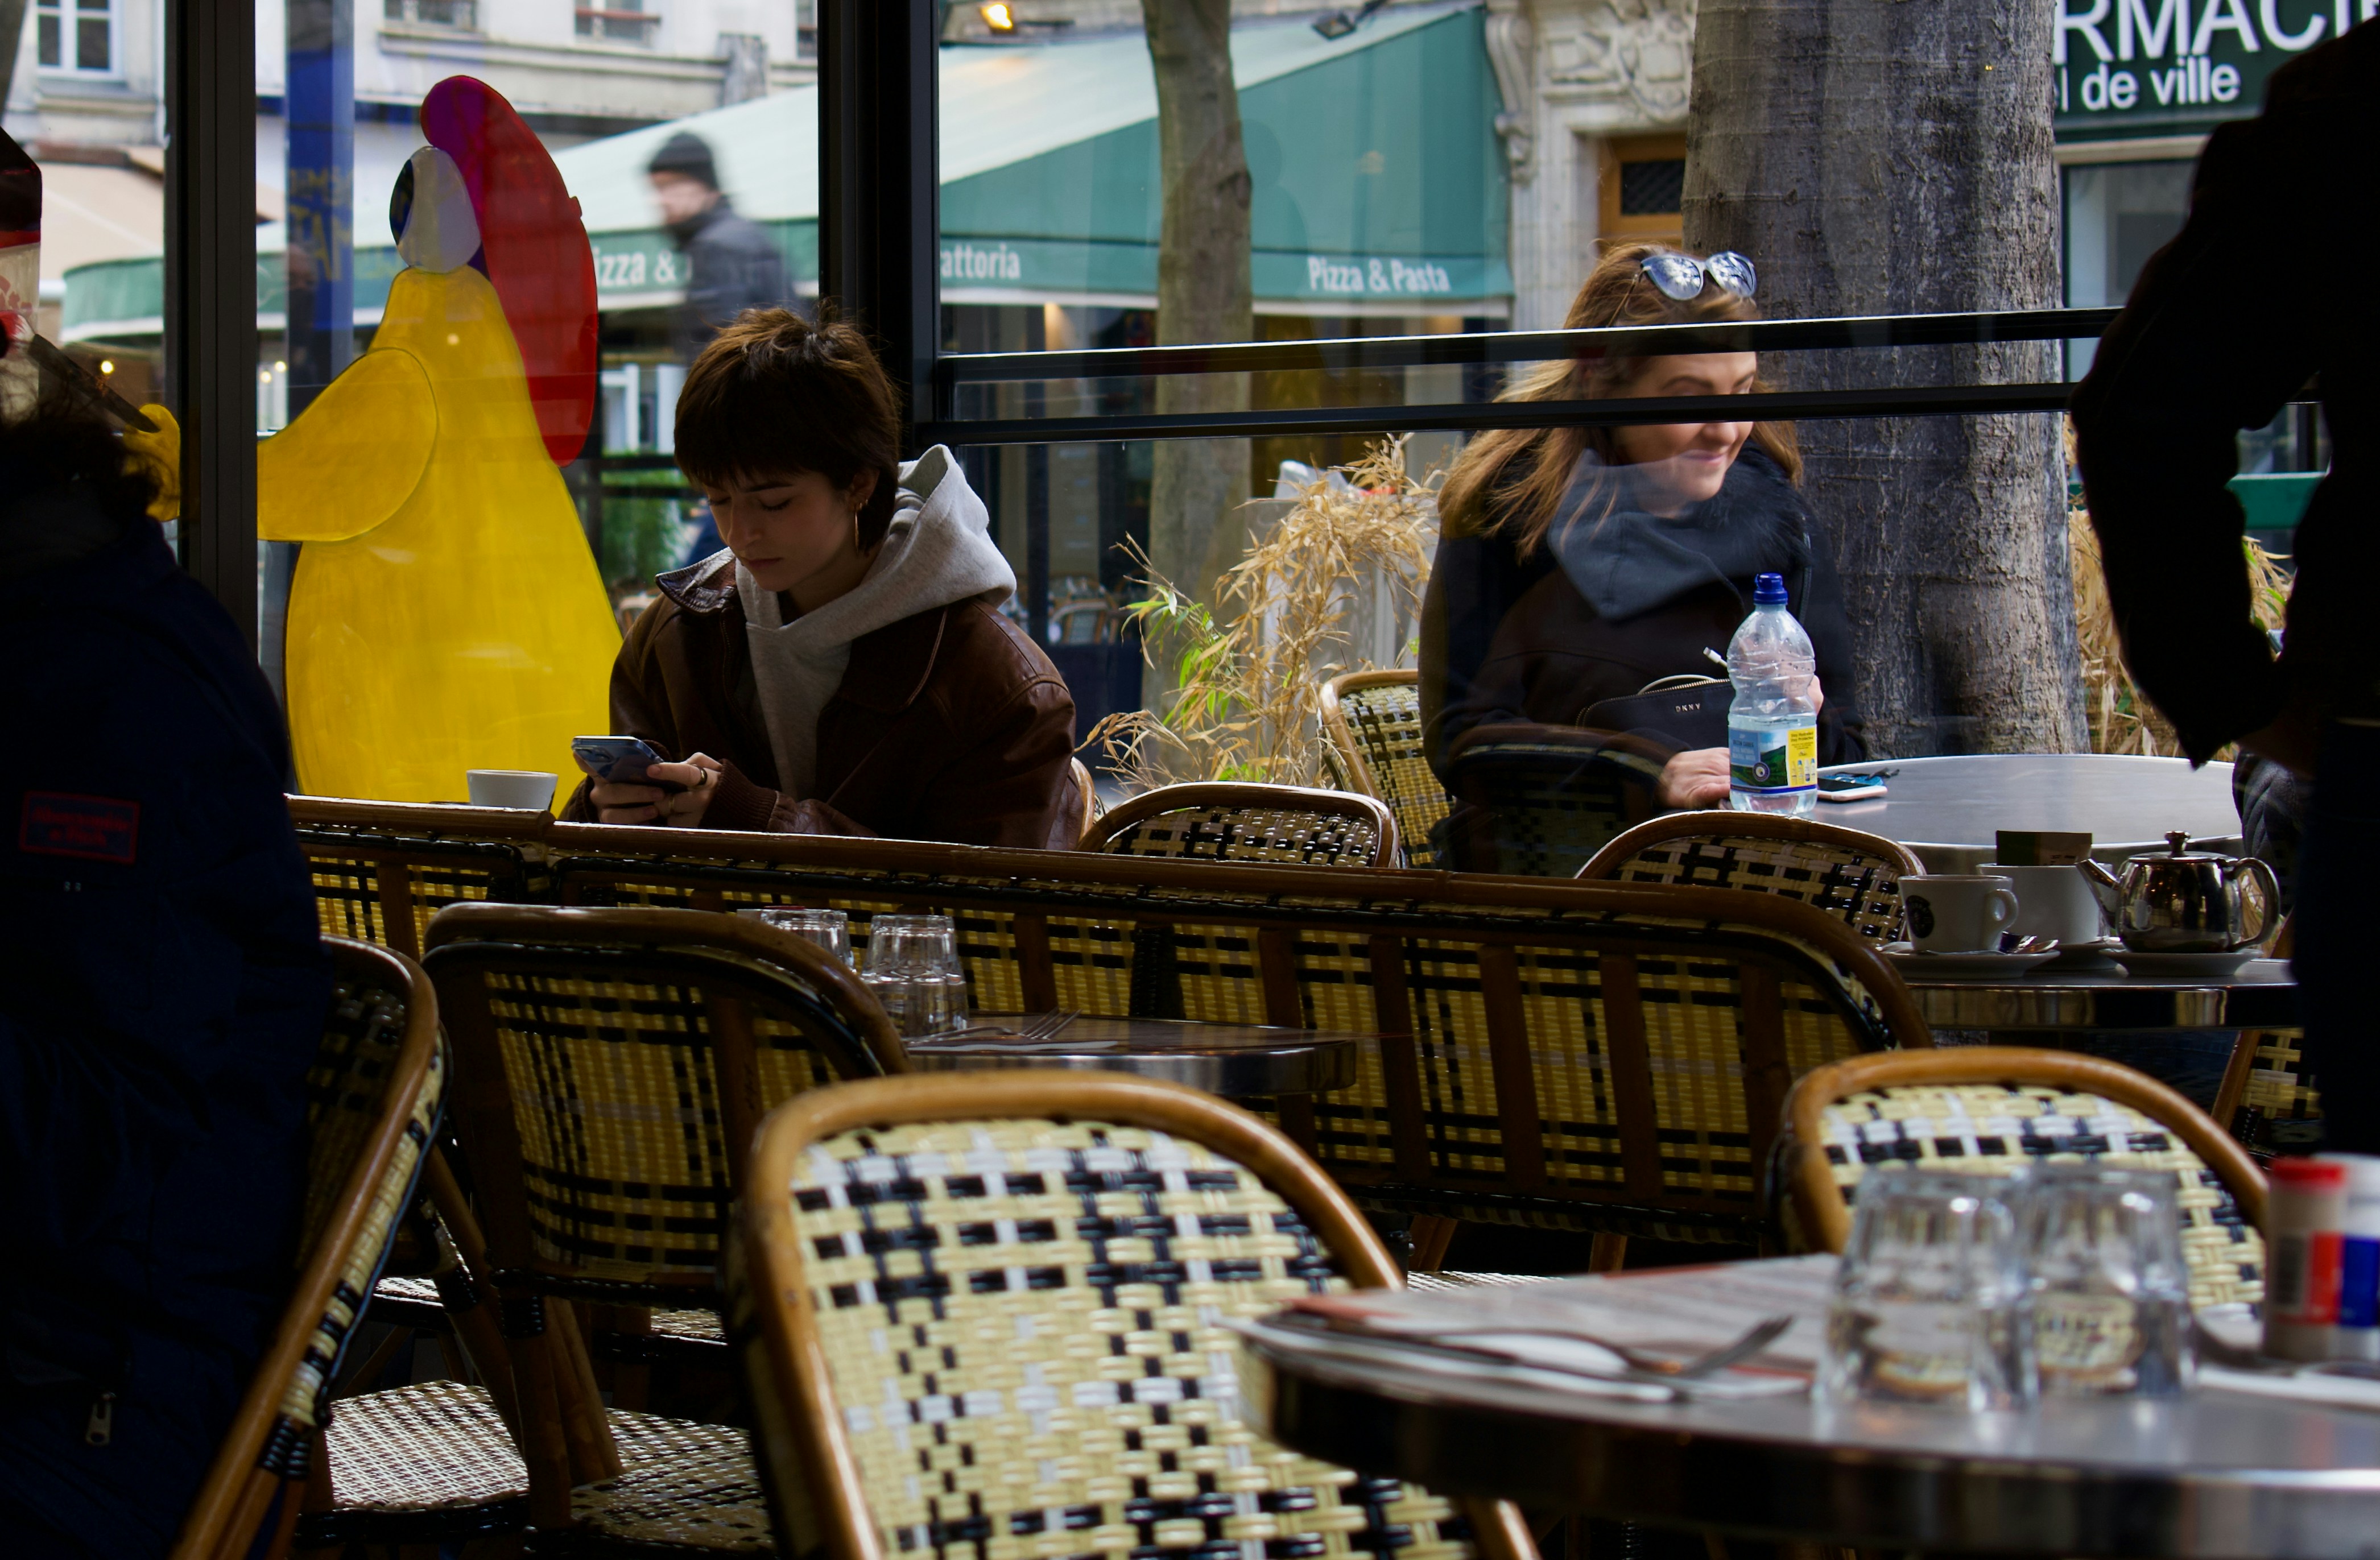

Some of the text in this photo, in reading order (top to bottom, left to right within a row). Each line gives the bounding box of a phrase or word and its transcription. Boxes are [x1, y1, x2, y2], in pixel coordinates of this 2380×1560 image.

[2052, 0, 2380, 64] RMACI
[2054, 56, 2241, 111] l de ville
[655, 250, 677, 283] &
[1308, 256, 1450, 292] Pizza & Pasta
[1675, 703, 1700, 712] DKNY
